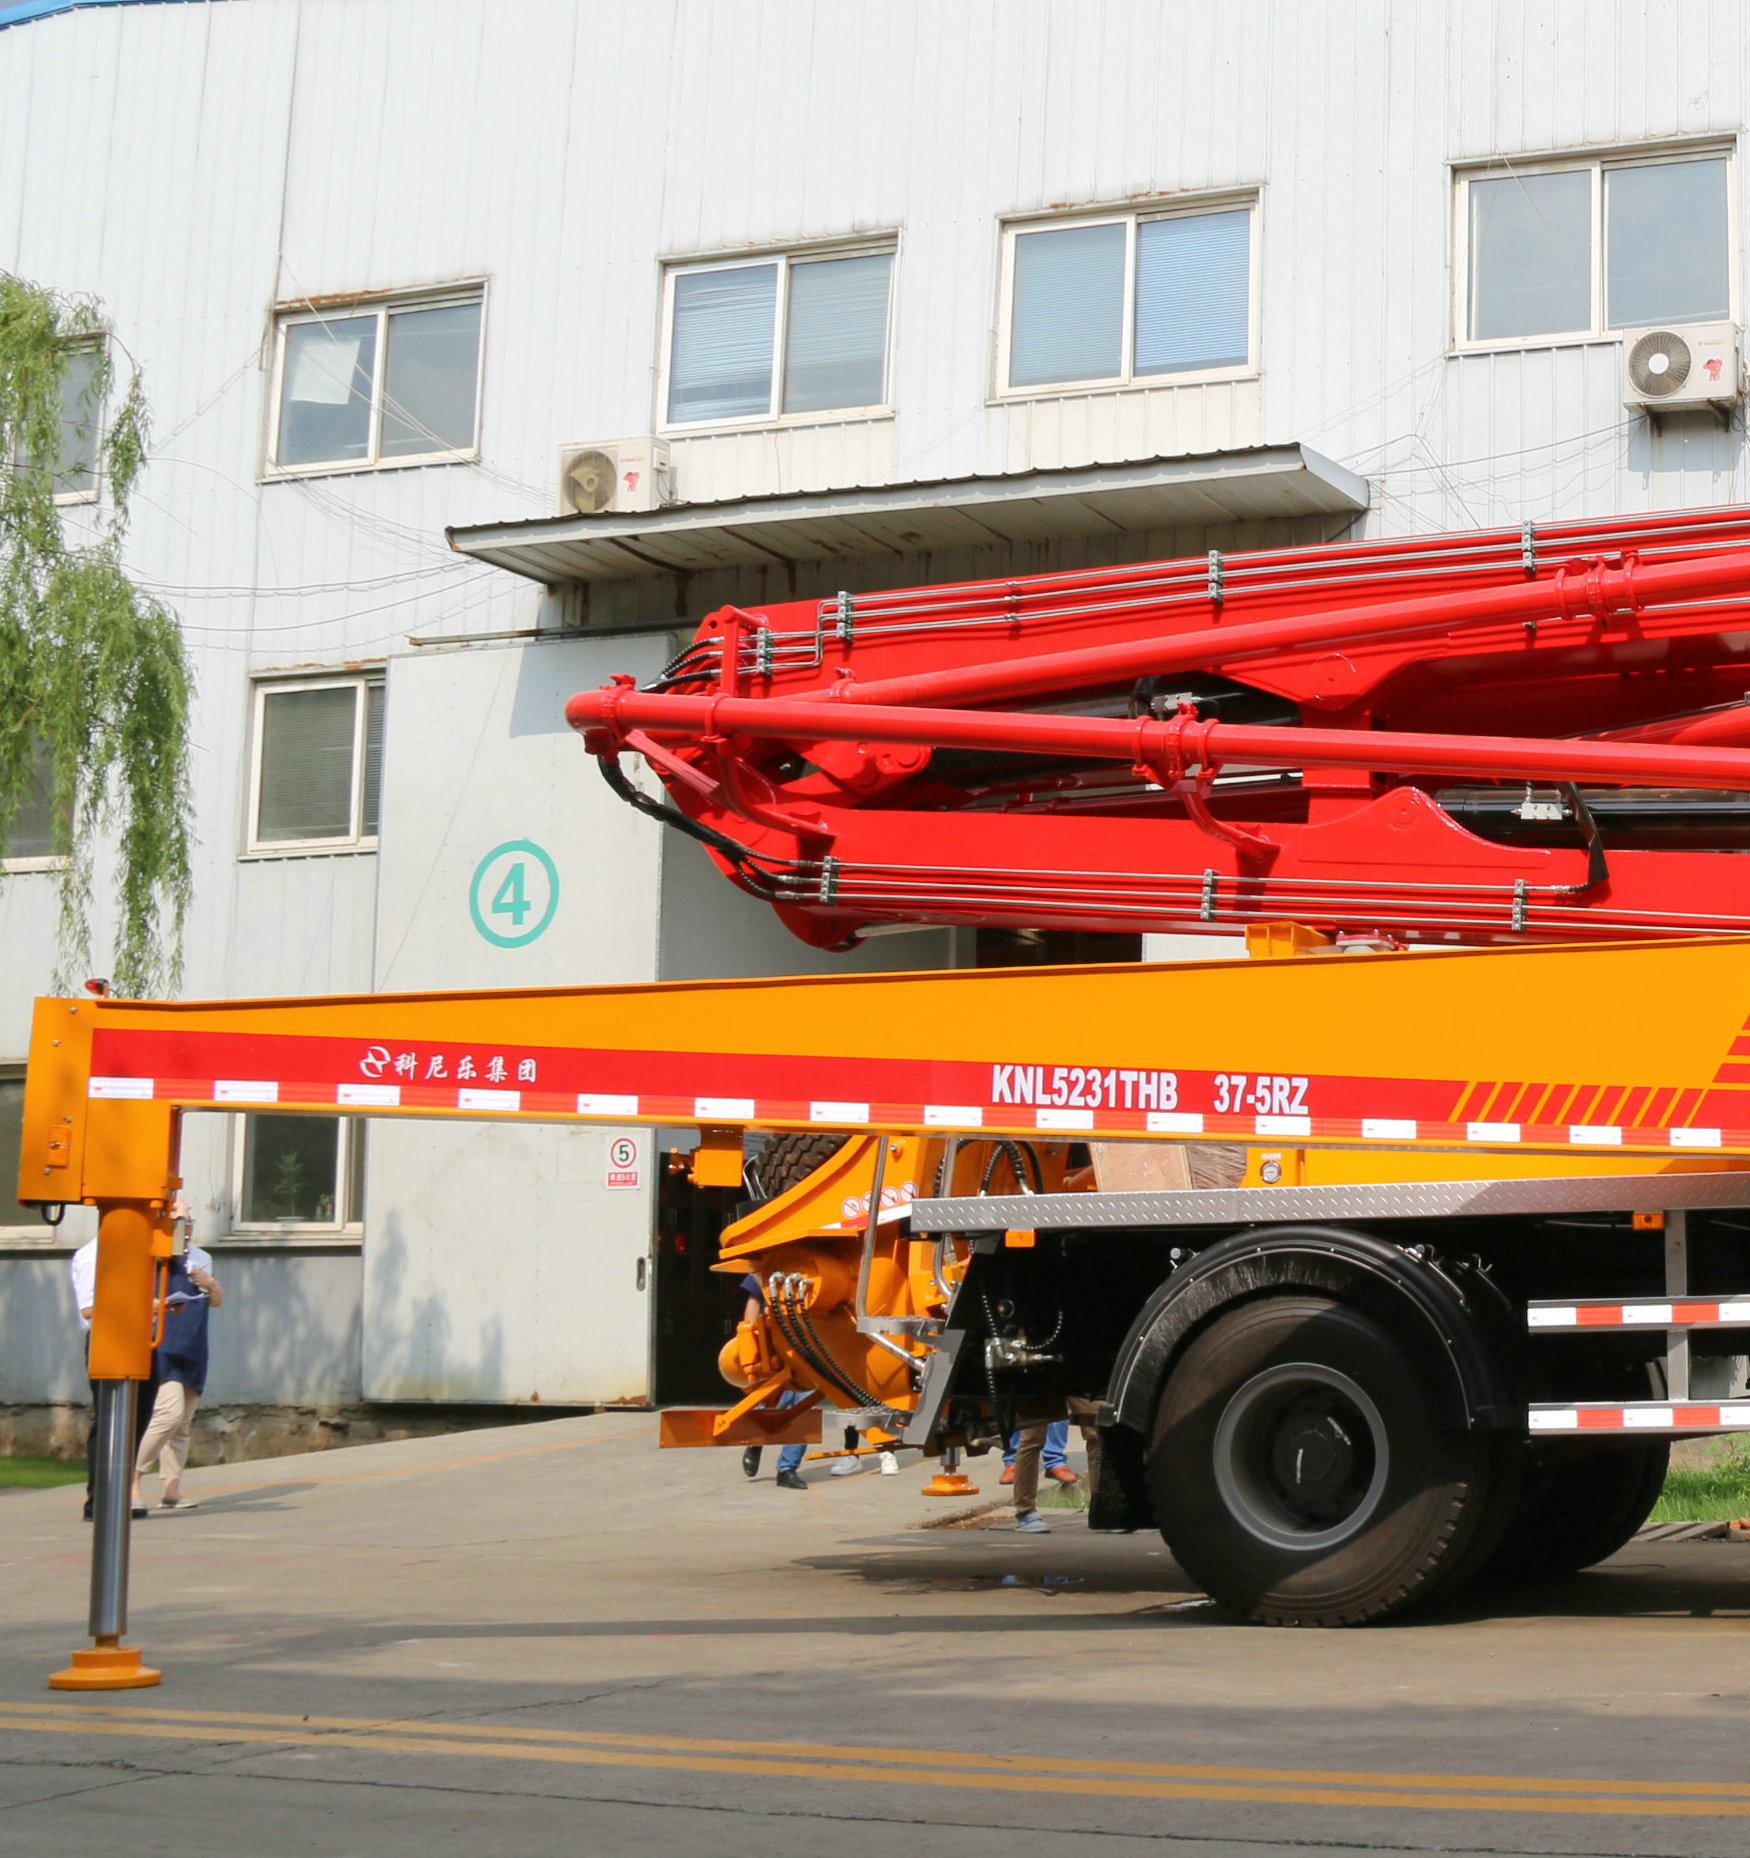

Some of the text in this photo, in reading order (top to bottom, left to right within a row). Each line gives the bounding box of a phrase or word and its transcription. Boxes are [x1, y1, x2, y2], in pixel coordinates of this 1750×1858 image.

[491, 863, 532, 926] 4
[393, 1052, 537, 1083] 科尼乐集团
[992, 1063, 1309, 1115] KNL5231THB 37-5RZ
[619, 1144, 630, 1162] 5
